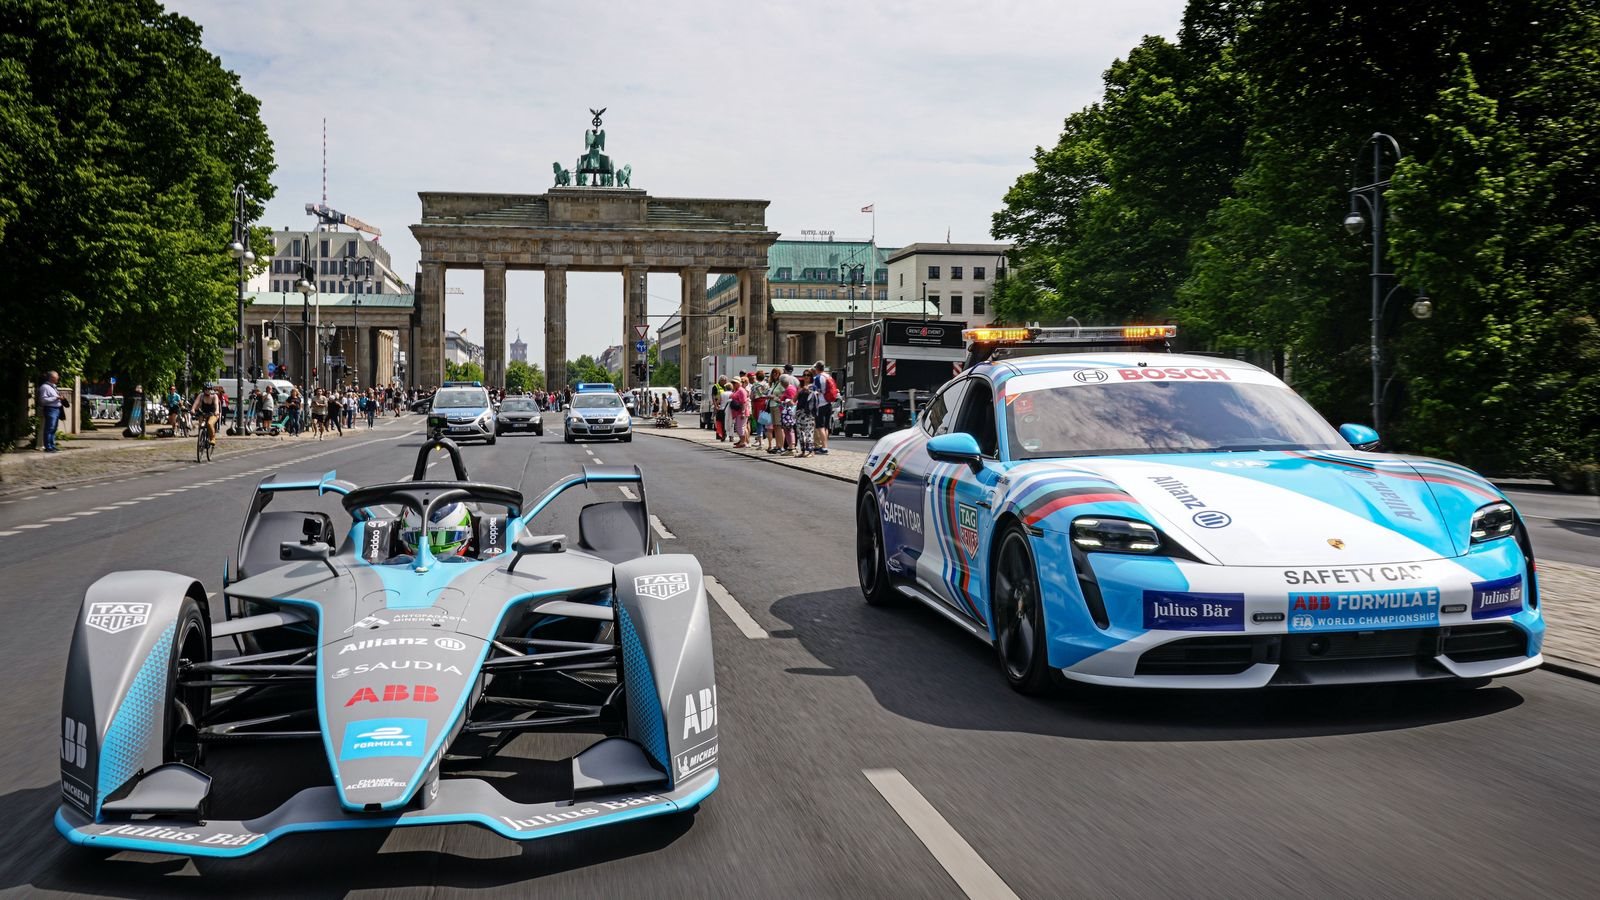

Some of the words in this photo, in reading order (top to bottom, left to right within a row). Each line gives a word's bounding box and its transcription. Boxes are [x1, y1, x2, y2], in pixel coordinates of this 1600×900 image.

[921, 327, 928, 336] 4
[1117, 368, 1231, 380] BOSCH
[1147, 476, 1207, 509] Allianz
[1365, 480, 1423, 521] Allianz
[883, 501, 909, 528] SAFETY
[960, 508, 976, 528] TAG
[961, 528, 978, 548] HEUER
[640, 575, 683, 584] TAG
[1284, 567, 1376, 585] SAFETY
[639, 583, 685, 597] HEUER
[1480, 591, 1509, 608] Julius
[1510, 587, 1520, 600] Bär
[96, 605, 145, 613] TAG
[1154, 602, 1198, 618] Julius
[1202, 603, 1232, 617] Bär
[1293, 595, 1331, 611] ABB
[1337, 592, 1423, 610] FORMULA
[1427, 590, 1437, 606] E
[90, 616, 144, 630] HEUER
[1293, 616, 1313, 628] FIA
[1317, 617, 1355, 626] WORLD
[1359, 612, 1436, 625] CHAMPIONSHIP
[338, 637, 428, 655] Allianz
[353, 660, 463, 676] SAUDIA
[343, 684, 440, 707] ABB
[683, 684, 718, 740] AB
[353, 741, 403, 749] FORMULA
[63, 781, 91, 805] MICHELIN
[502, 806, 598, 831] Julius
[595, 794, 659, 811] Bär
[100, 824, 200, 841] Julius
[200, 832, 265, 845] Bär
